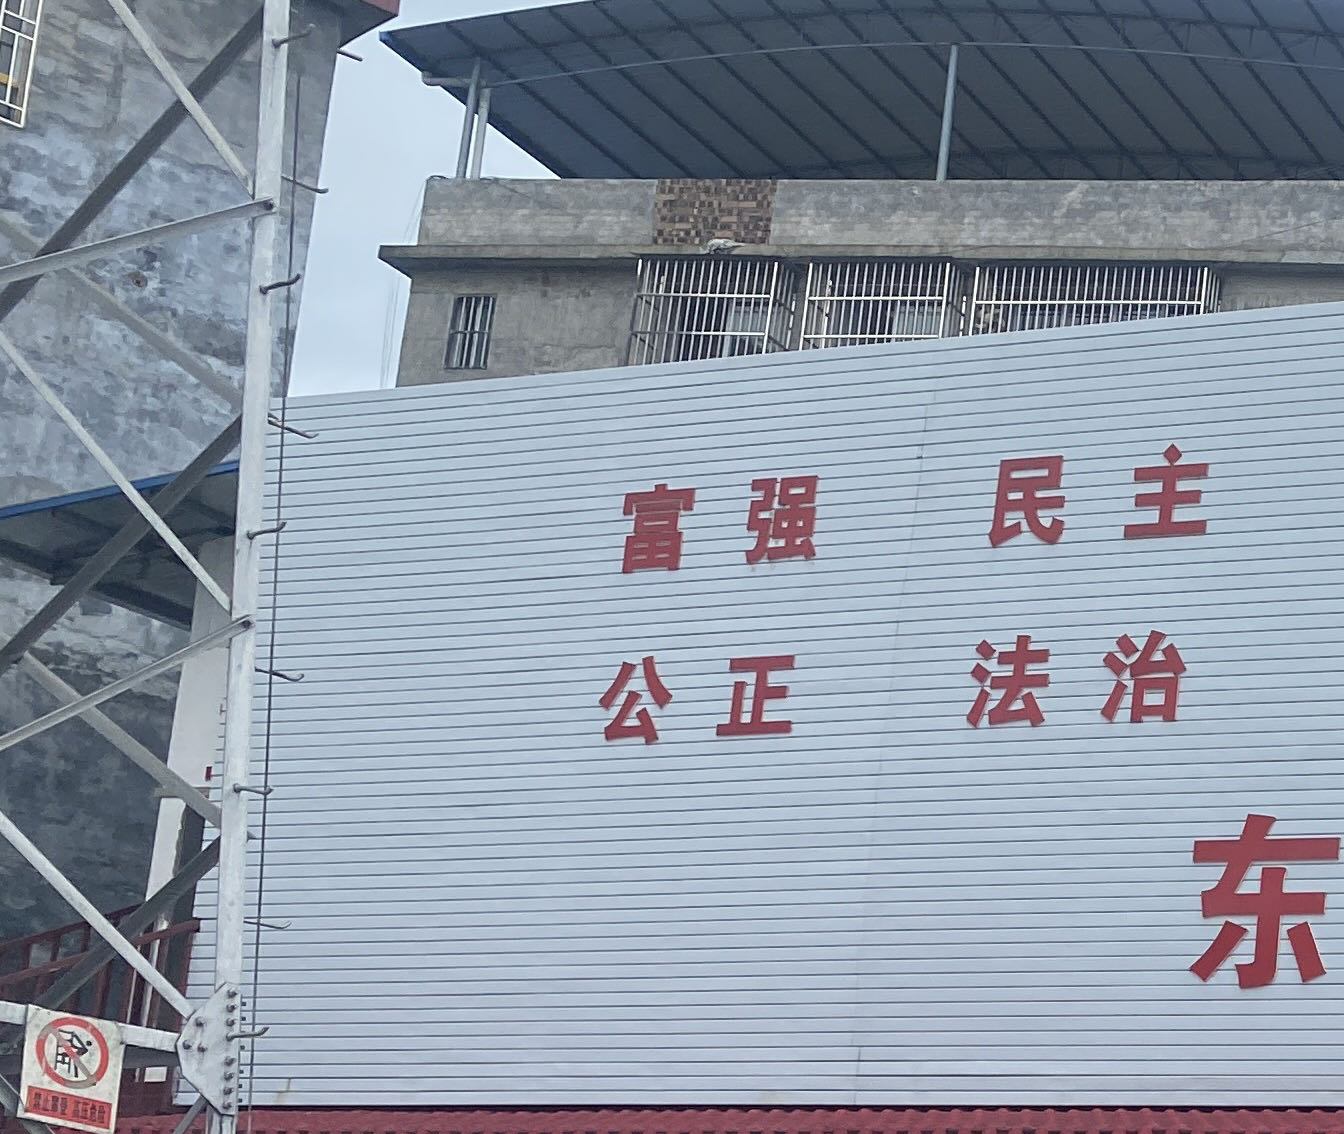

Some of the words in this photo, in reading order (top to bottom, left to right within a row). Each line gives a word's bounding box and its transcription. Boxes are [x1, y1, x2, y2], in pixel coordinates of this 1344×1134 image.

[624, 478, 819, 573] 富强
[988, 443, 1210, 548] 民主
[599, 653, 796, 744] 公正
[966, 629, 1188, 728] 法治
